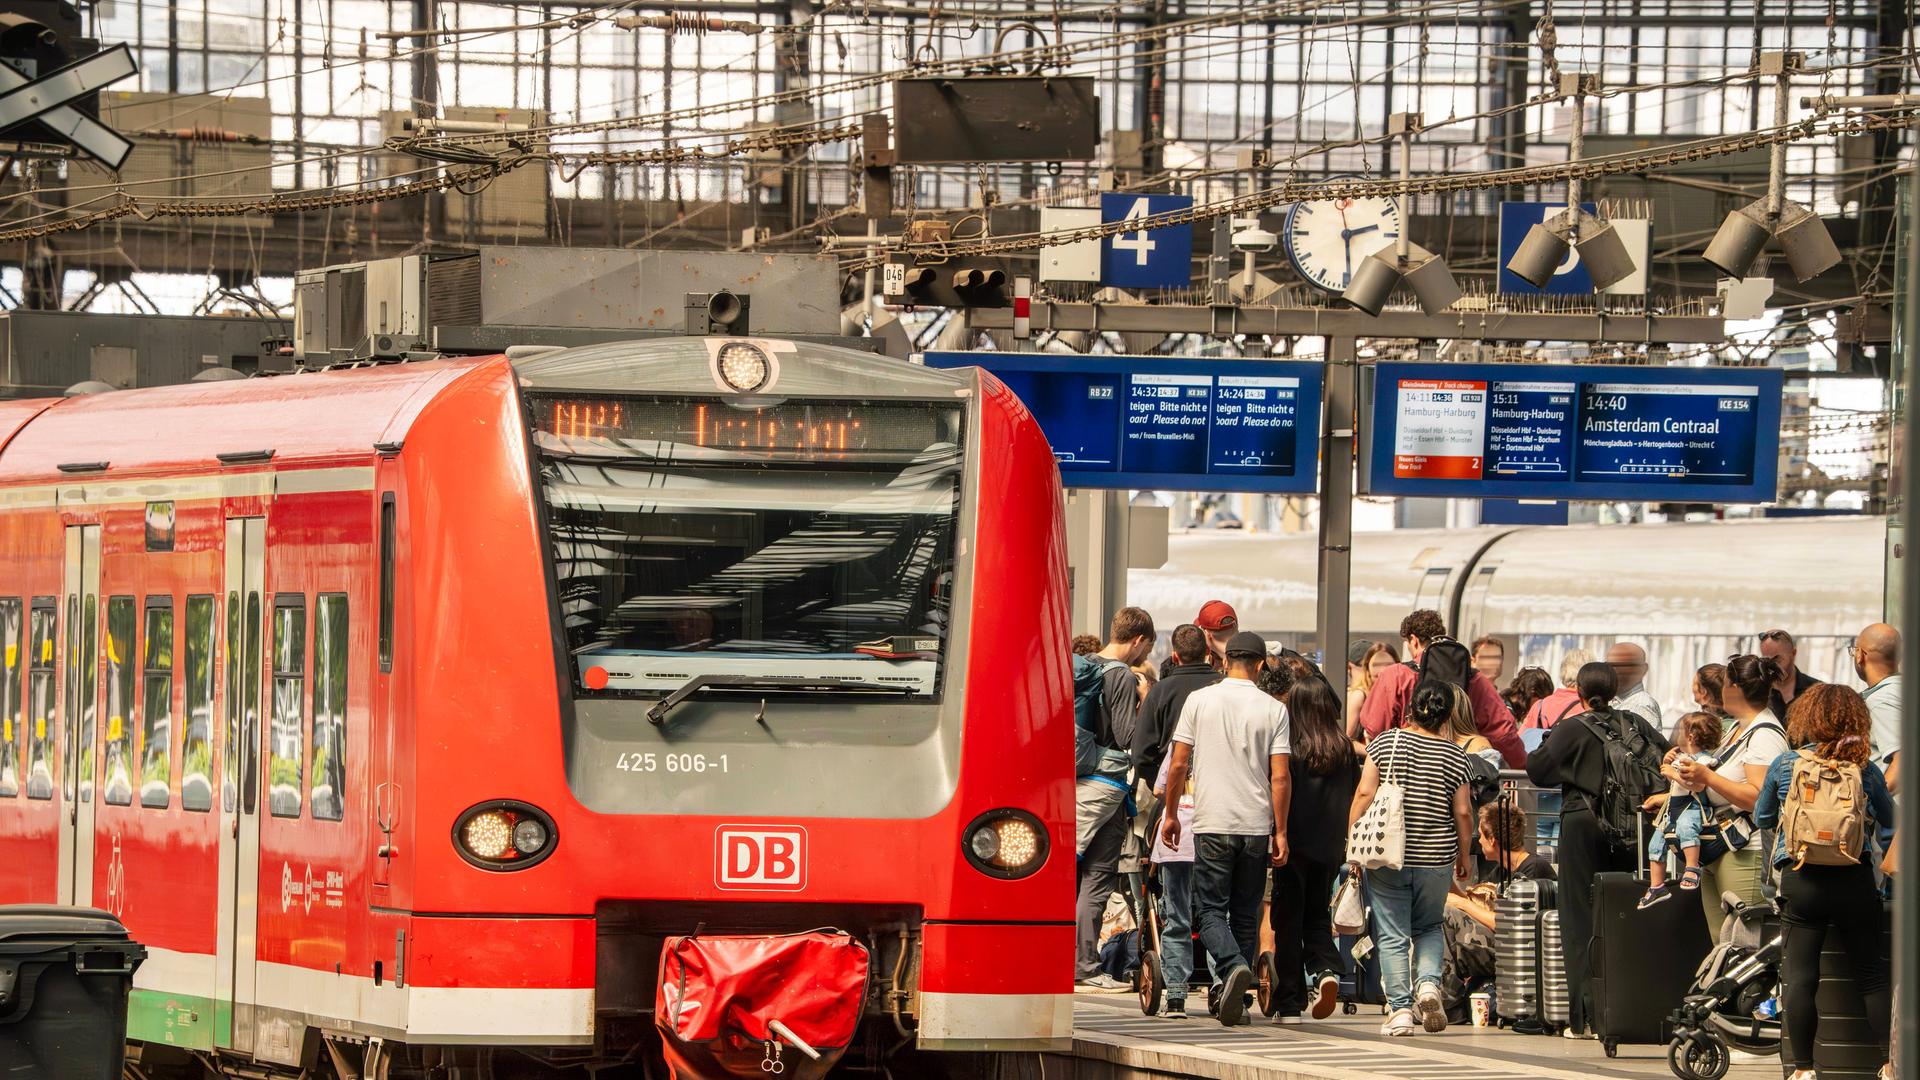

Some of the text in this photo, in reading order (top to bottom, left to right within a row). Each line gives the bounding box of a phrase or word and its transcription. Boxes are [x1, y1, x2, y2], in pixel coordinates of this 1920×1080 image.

[1112, 197, 1155, 265] 4
[1090, 388, 1112, 397] RB 27
[1131, 387, 1156, 397] 14:32
[1218, 389, 1244, 399] 14:24
[1406, 393, 1452, 402] 14:11 14:36
[1493, 394, 1519, 404] 15:11
[1586, 395, 1627, 411] 14:40
[1130, 402, 1155, 413] teigen
[1160, 401, 1179, 411] Bitte
[1181, 402, 1201, 412] nicht
[1217, 404, 1241, 415] teigen
[1247, 403, 1266, 413] Bitte
[1267, 404, 1287, 414] nicht
[1720, 400, 1749, 410] ICE 154
[1404, 406, 1476, 419] Hamburg-Harburg
[1492, 408, 1564, 421] Hamburg-Harburg
[1153, 414, 1179, 424] Please
[1180, 415, 1191, 425] do
[1192, 416, 1206, 425] not
[1243, 416, 1269, 426] Please
[1270, 417, 1281, 426] do
[1585, 416, 1720, 434] Amsterdam Centraal
[1583, 439, 1633, 448] Mönchengladbach
[1472, 458, 1479, 469] 2
[266, 599, 272, 657] 2
[616, 753, 728, 773] 425 606-1
[728, 836, 796, 880] DB
